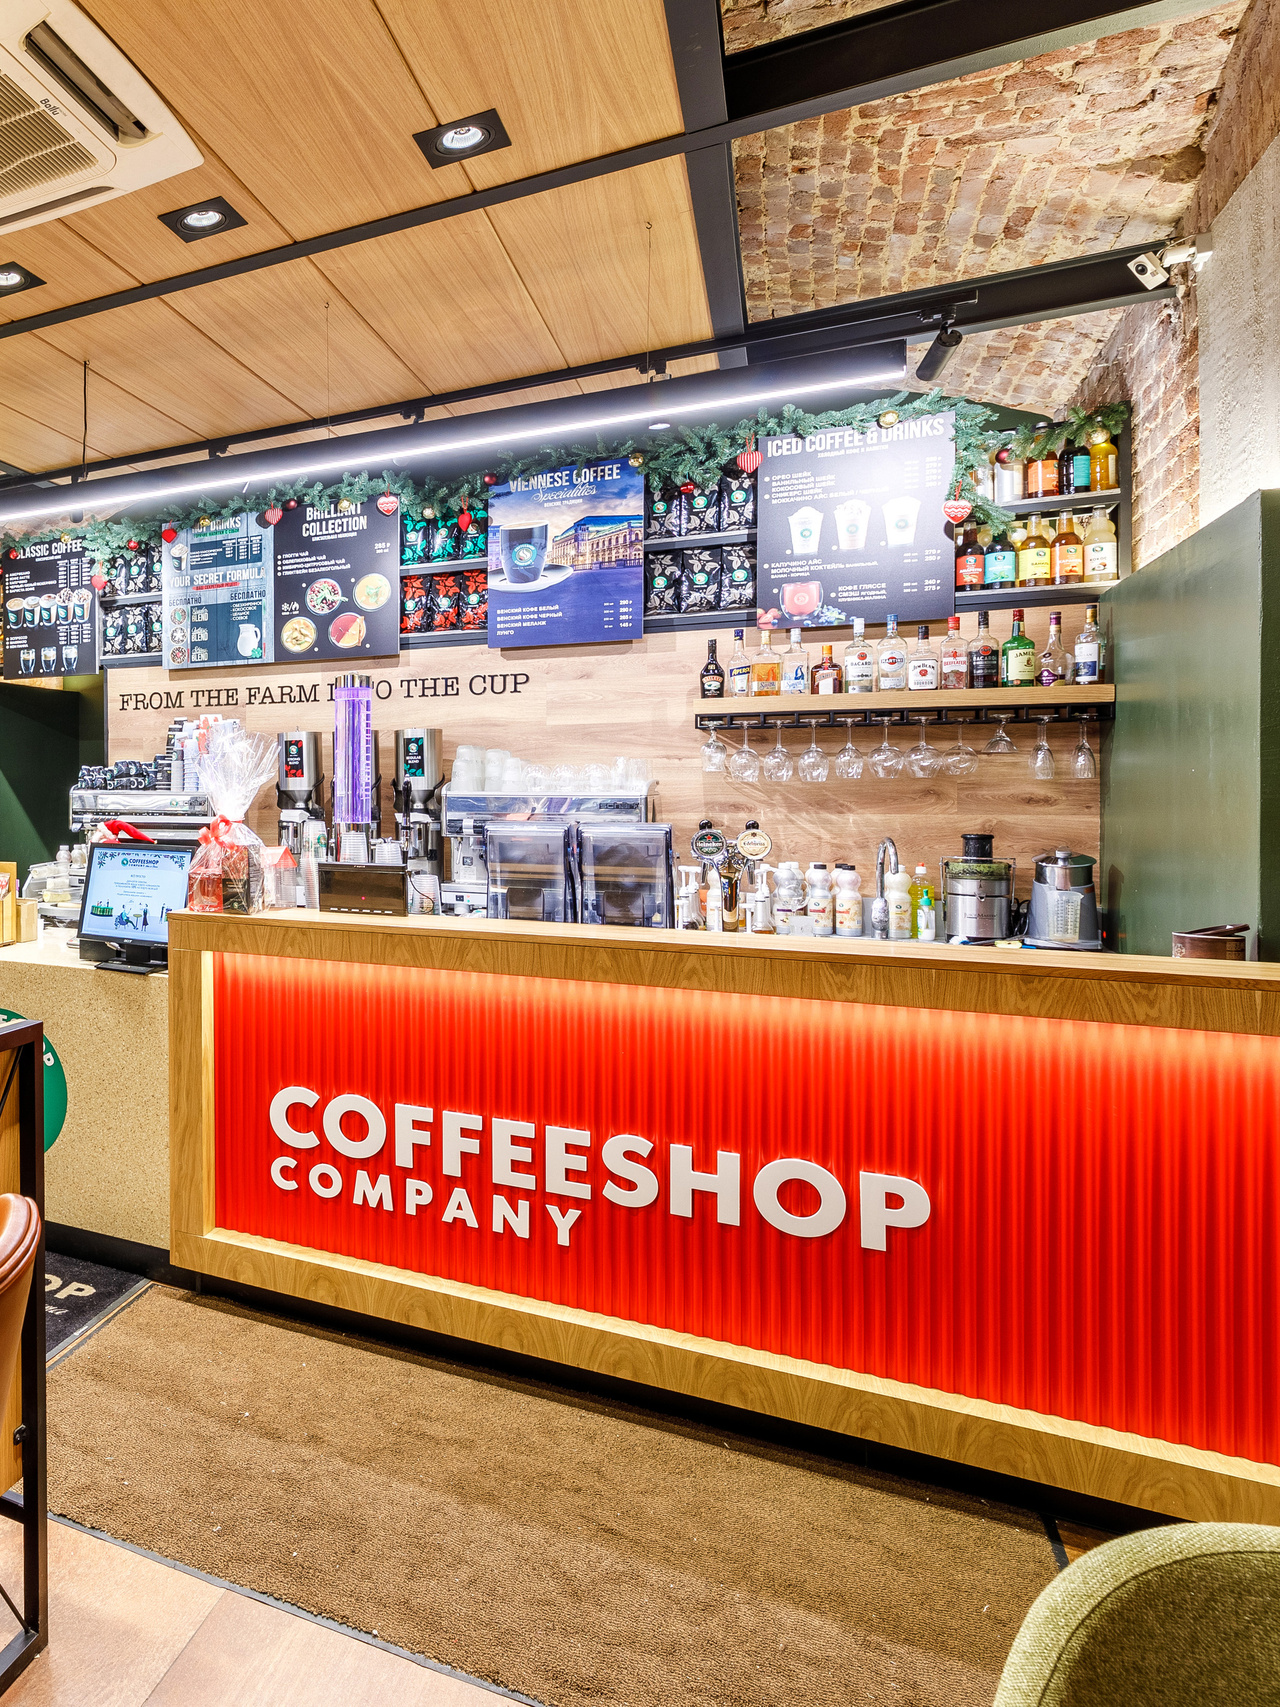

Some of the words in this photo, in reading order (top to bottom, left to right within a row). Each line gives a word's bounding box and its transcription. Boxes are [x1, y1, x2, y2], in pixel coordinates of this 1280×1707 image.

[40, 98, 59, 116] Ballu
[767, 438, 802, 458] ICED
[805, 430, 864, 452] COFFEE
[881, 418, 945, 442] DRINKS
[509, 471, 570, 493] VIENNESE
[572, 464, 621, 484] COFFEE
[772, 477, 814, 487] ВАНИЛЬНЫЙ
[816, 474, 836, 482] ШЕЙК
[772, 483, 814, 492] КОКОСОВЫЙ
[816, 480, 836, 488] ШЕЙК
[803, 488, 823, 496] ШЕЙК
[210, 516, 241, 531] DRINKS
[302, 516, 368, 537] COLLECTION
[16, 543, 49, 559] LASSIC
[52, 540, 83, 555] COFFEE
[771, 560, 807, 568] КАПУЧИНО
[808, 558, 822, 566] АЙС
[771, 566, 810, 574] МОЛОЧНЫЙ
[810, 563, 844, 571] КОКТЕЙЛЬ
[170, 576, 190, 588] YOUR
[193, 572, 224, 585] SECRET
[227, 566, 266, 582] FORMULA
[858, 582, 886, 590] ГЛЯССЕ
[230, 590, 266, 601] БЕСПЛАТНО
[169, 597, 202, 607] БЕСПЛАТНО
[496, 607, 522, 615] ВЕНСКИЙ
[539, 604, 559, 612] БЕЛЫЙ
[192, 613, 208, 622] BLEND
[496, 614, 522, 622] ВЕНСКИЙ
[192, 633, 208, 642] BLEND
[192, 653, 208, 662] BLEND
[119, 690, 184, 711] FROM
[191, 688, 238, 707] THE
[246, 684, 320, 705] FARM
[327, 680, 392, 702] IO
[400, 677, 459, 698] THE
[469, 673, 530, 695] CUP
[269, 1086, 932, 1252] COFFEESHOP
[270, 1156, 582, 1246] COMPANY
